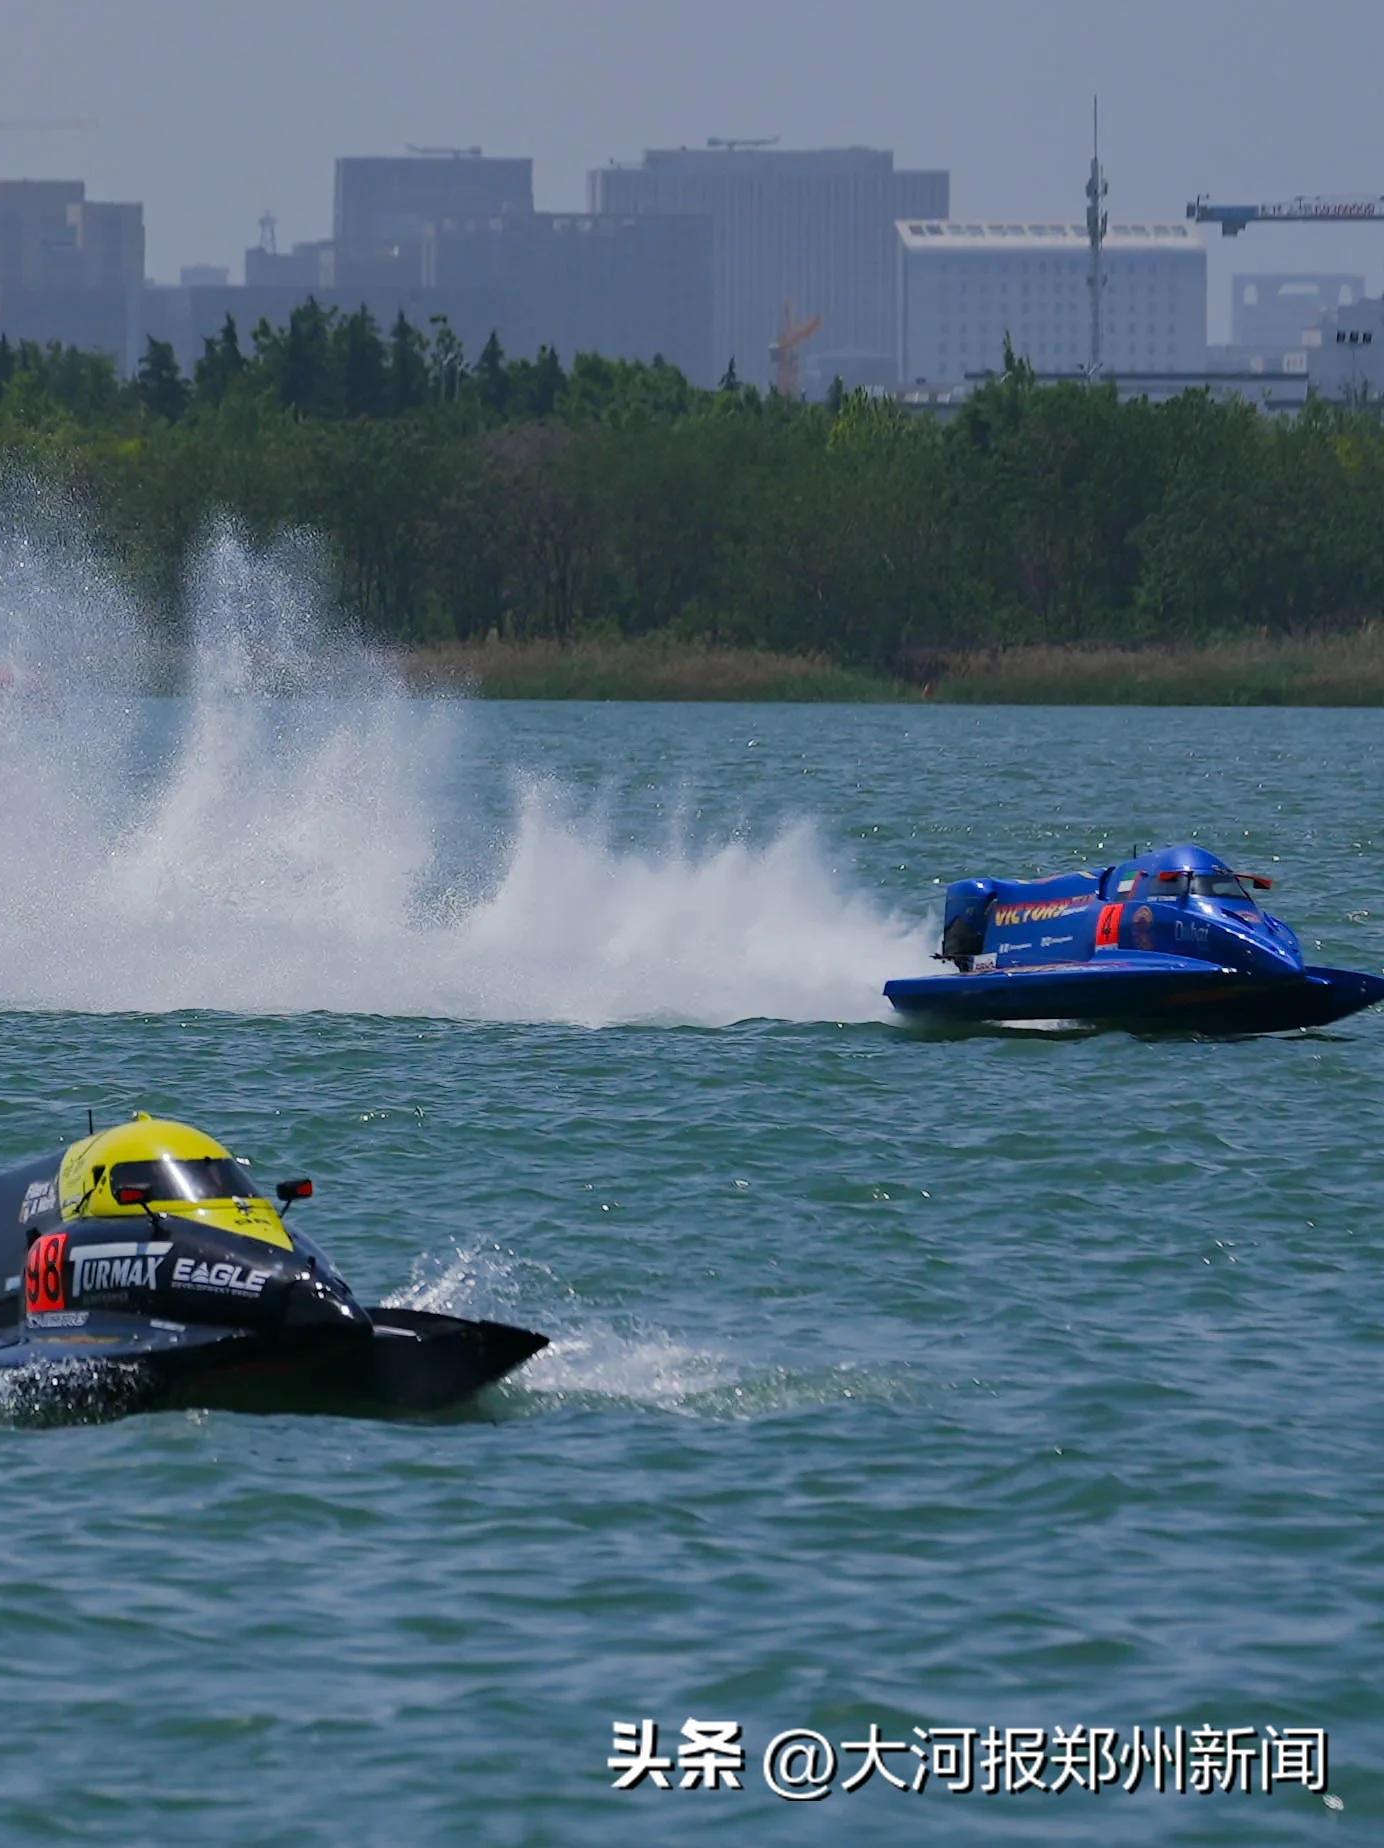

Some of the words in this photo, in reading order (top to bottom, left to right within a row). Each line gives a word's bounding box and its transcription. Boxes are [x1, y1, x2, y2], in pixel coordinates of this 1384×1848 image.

[26, 1237, 62, 1304] 98
[69, 1241, 174, 1298] TURMAX
[172, 1257, 273, 1292] EAGLE
